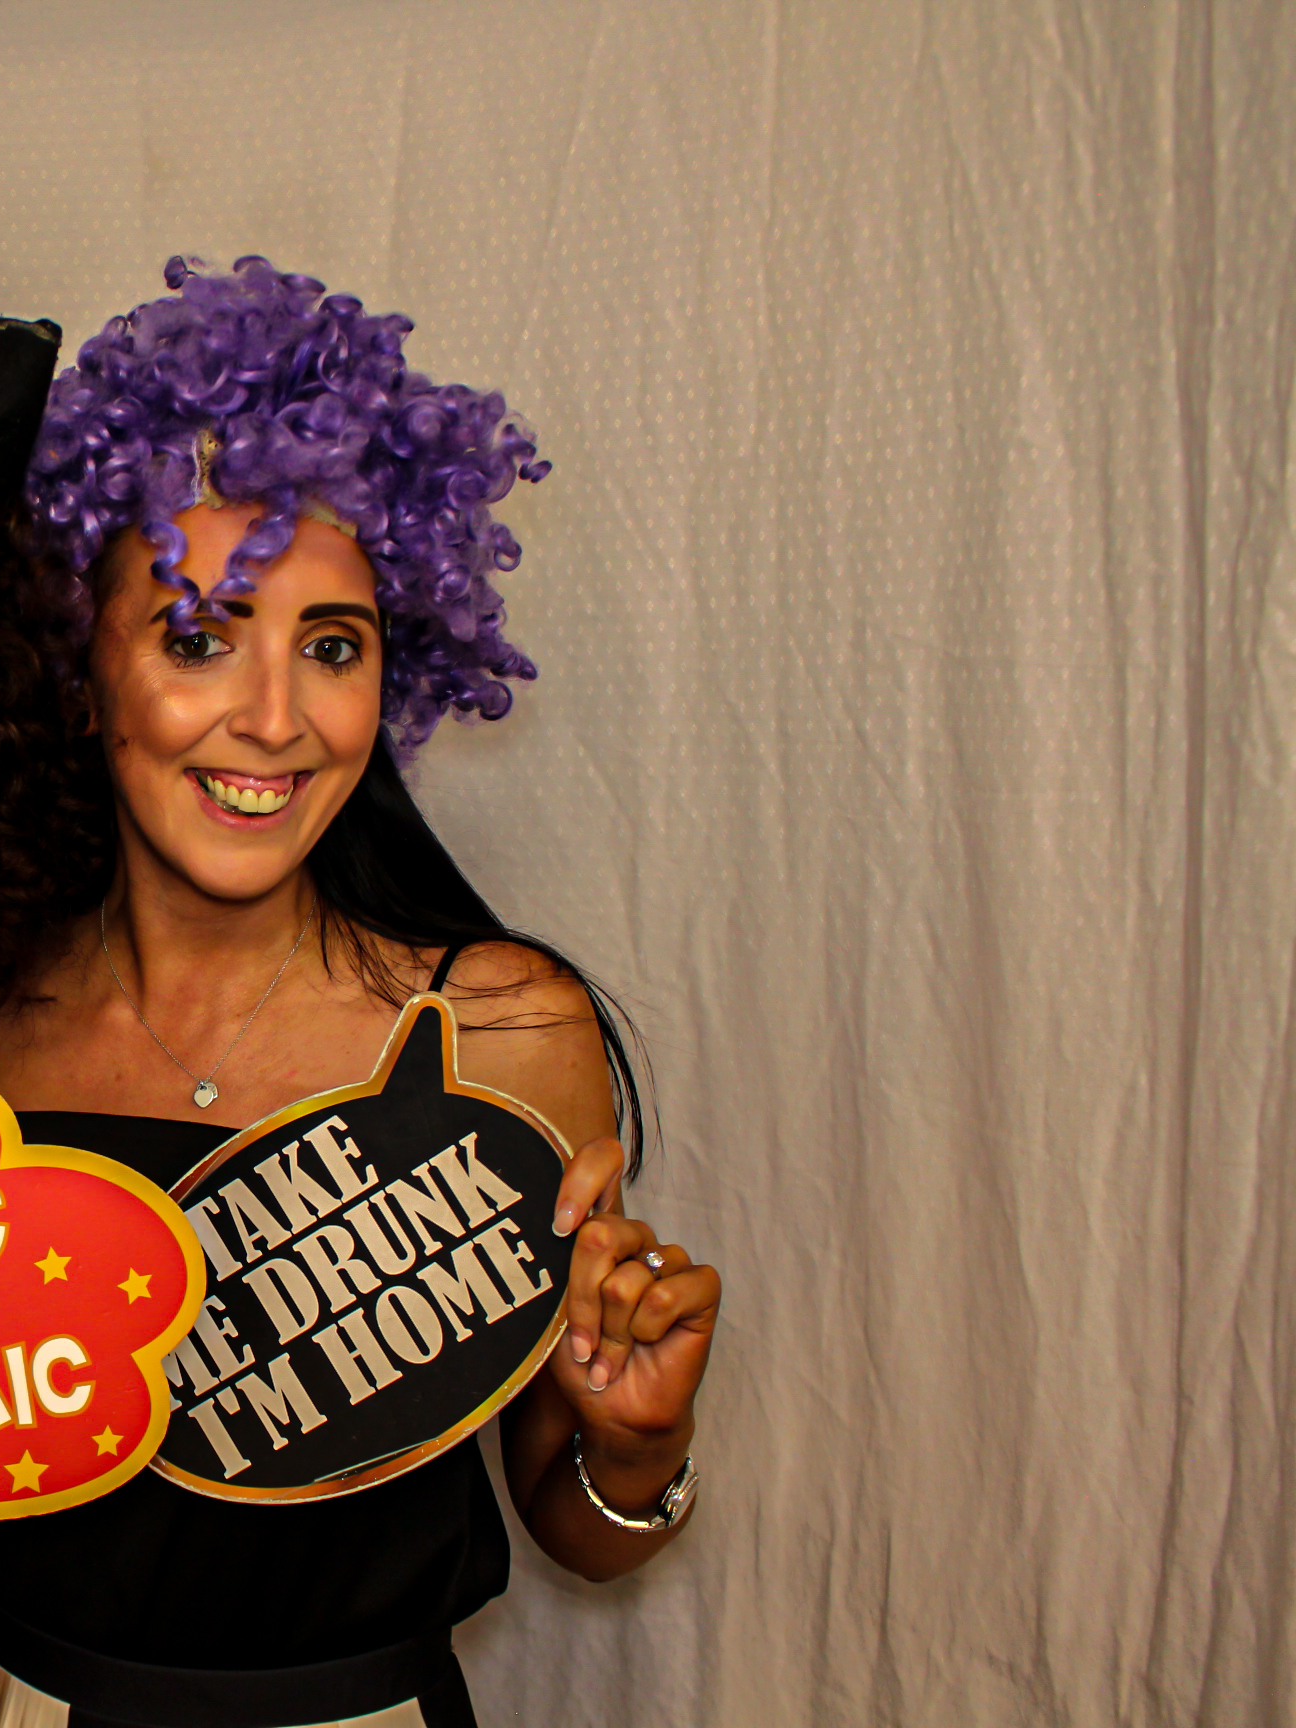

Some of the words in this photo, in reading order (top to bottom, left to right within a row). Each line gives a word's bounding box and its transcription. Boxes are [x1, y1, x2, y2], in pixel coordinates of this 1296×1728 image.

[184, 1115, 379, 1281] TAKE
[242, 1132, 522, 1345] DRUNK
[188, 1353, 327, 1479] I'M
[312, 1217, 553, 1405] HOME
